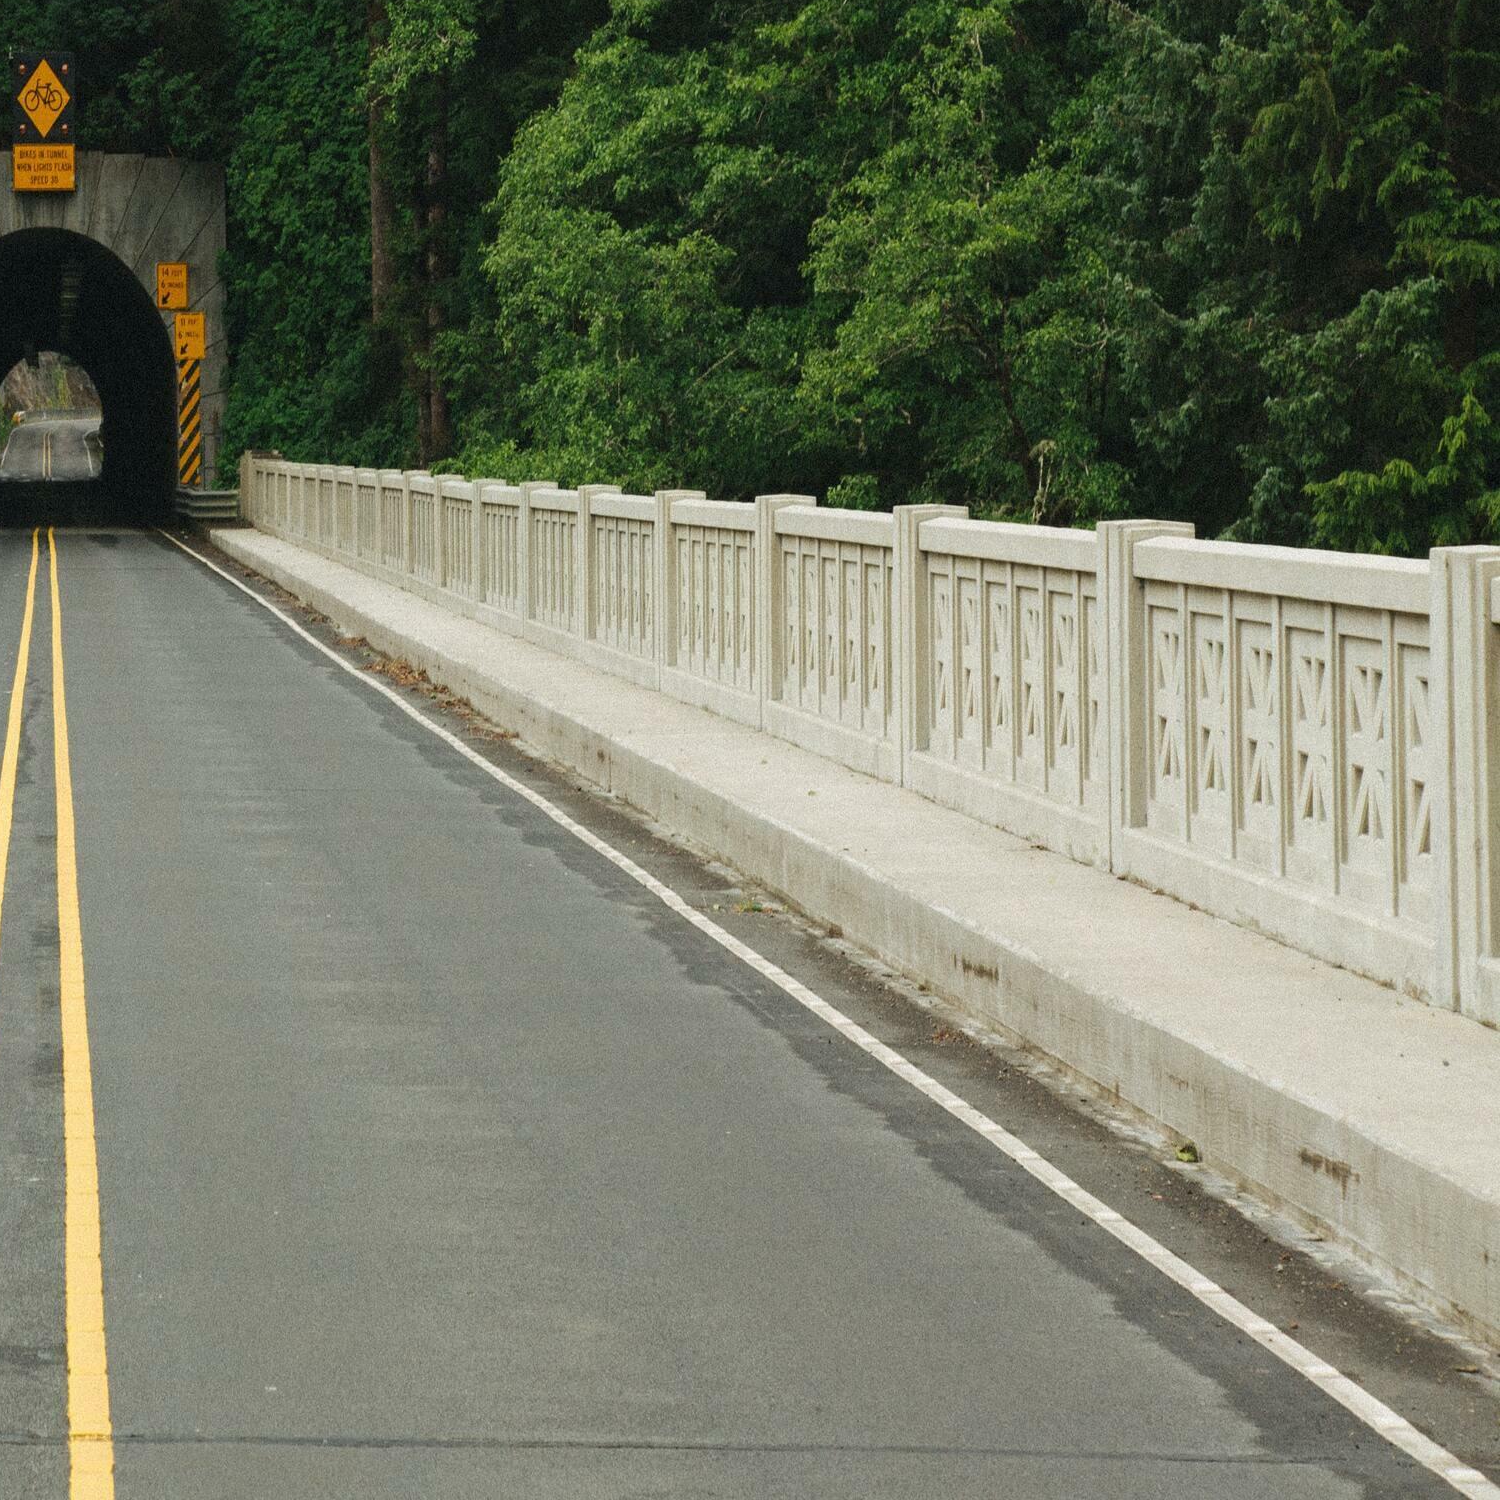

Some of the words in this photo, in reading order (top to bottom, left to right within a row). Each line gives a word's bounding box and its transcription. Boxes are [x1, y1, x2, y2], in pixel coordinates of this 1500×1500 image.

[47, 149, 68, 159] TUNNEL
[34, 163, 53, 172] LIGHTS
[54, 163, 72, 171] FLASH
[30, 175, 49, 185] SPEED
[161, 267, 169, 277] 14
[160, 280, 166, 289] 6
